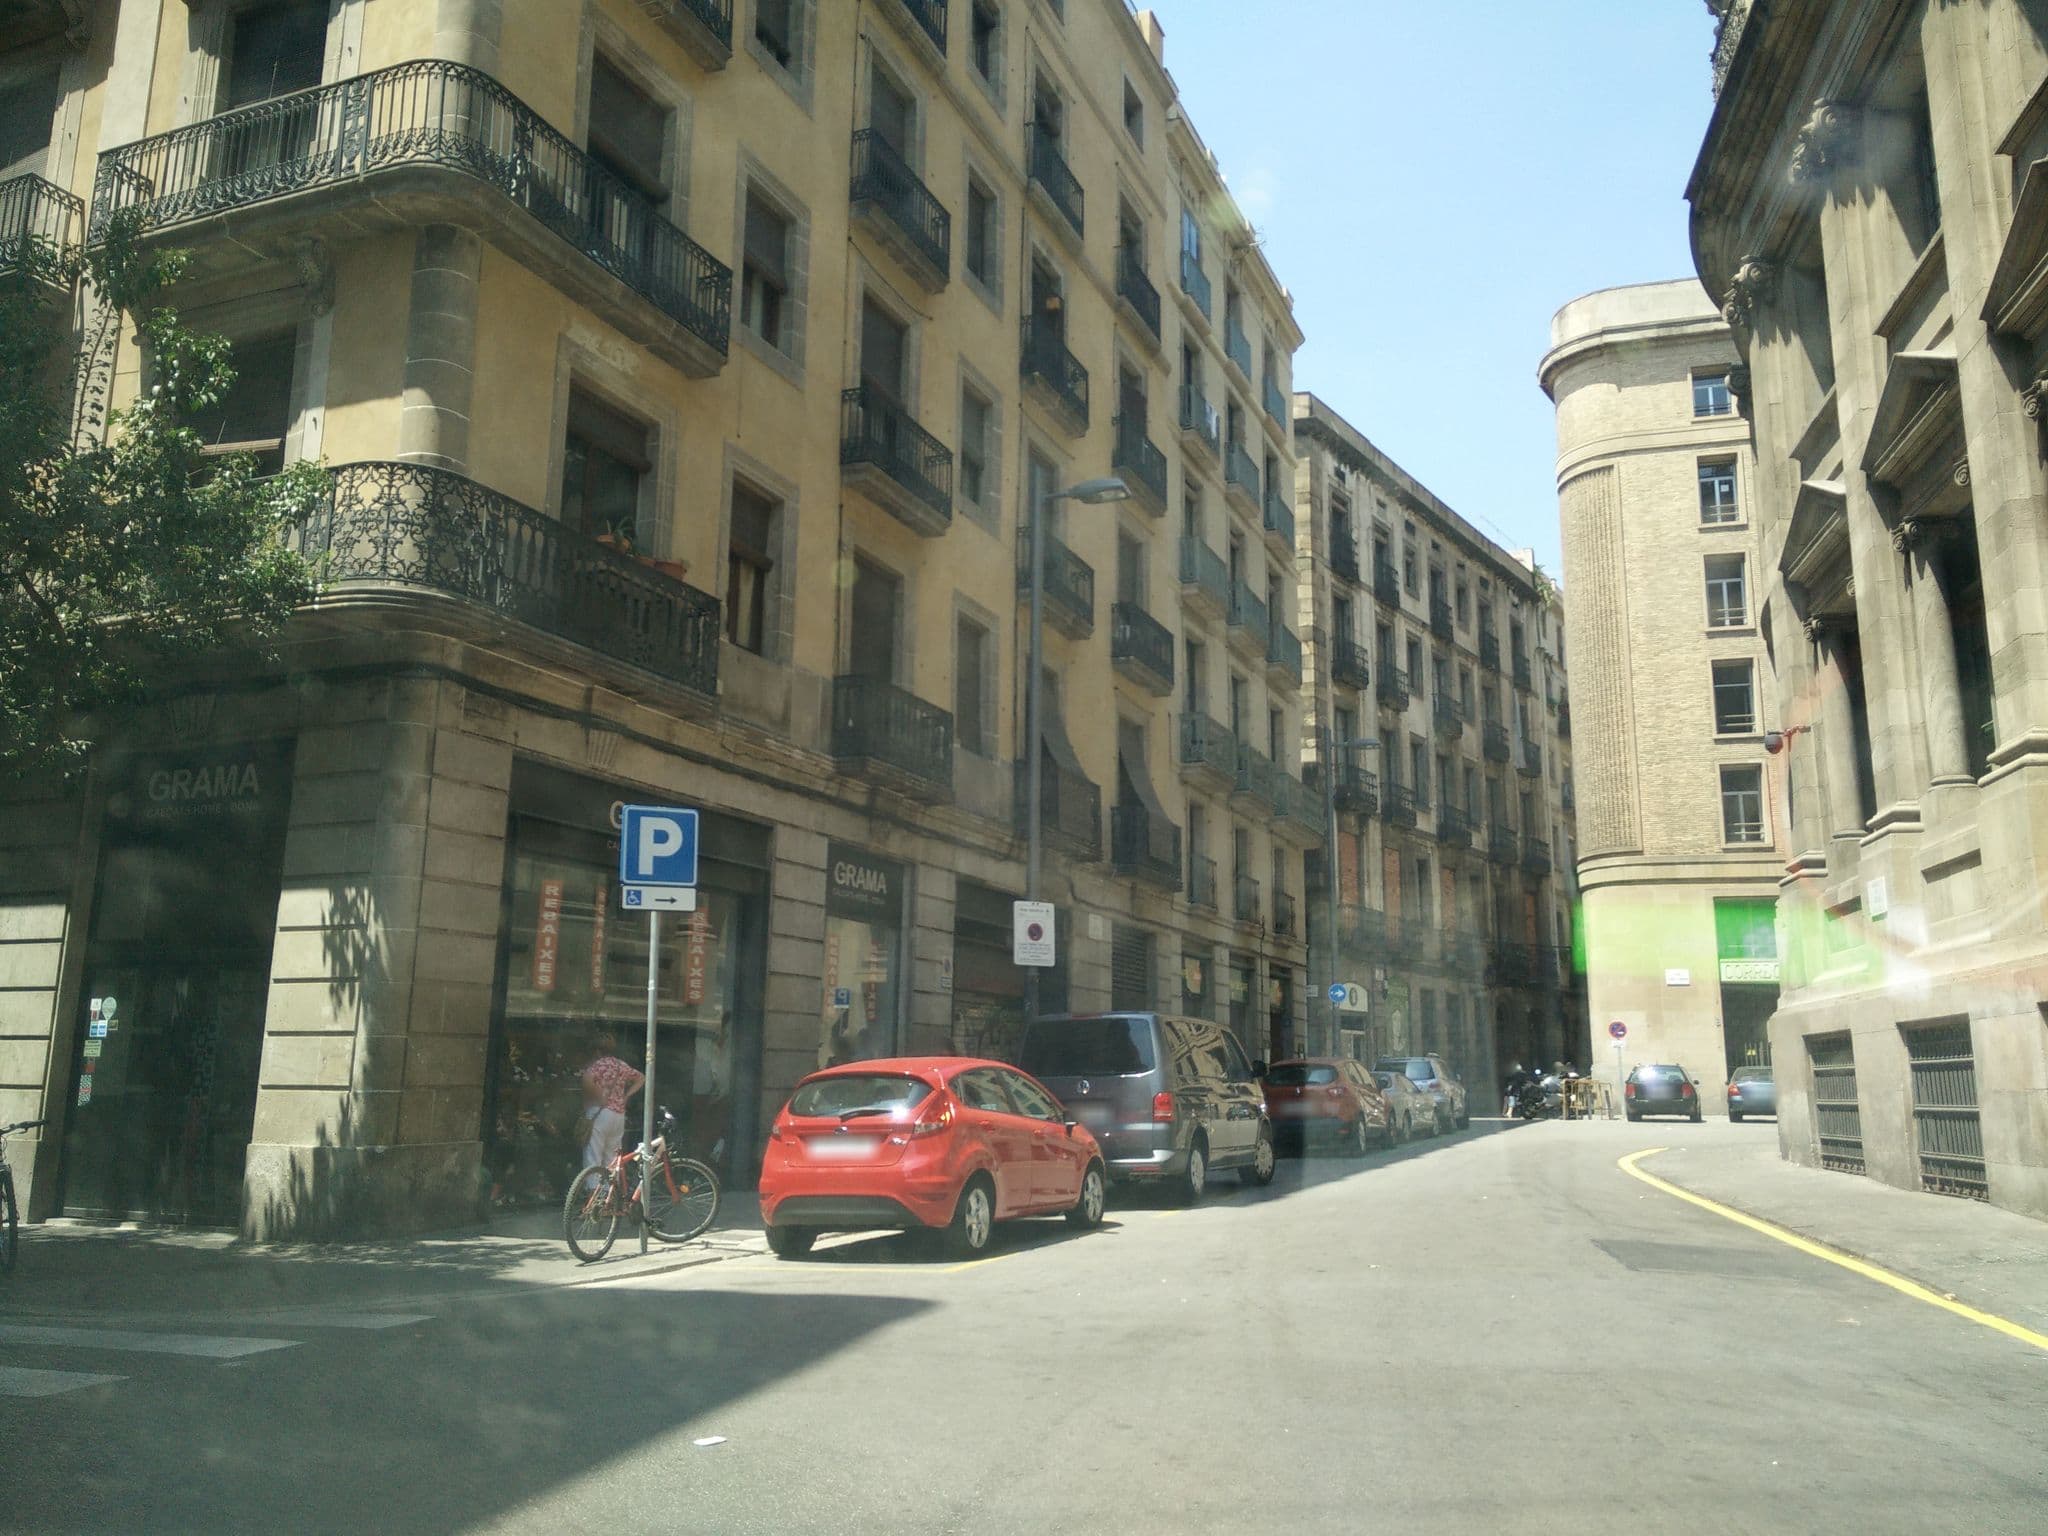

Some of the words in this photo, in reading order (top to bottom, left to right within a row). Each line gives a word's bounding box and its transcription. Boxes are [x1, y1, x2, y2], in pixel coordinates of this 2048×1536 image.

[148, 763, 260, 801] GRAMA
[638, 816, 684, 876] P
[834, 861, 888, 895] GRAMA
[538, 885, 560, 986] REBAIXES
[689, 911, 706, 1000] REBAIXES
